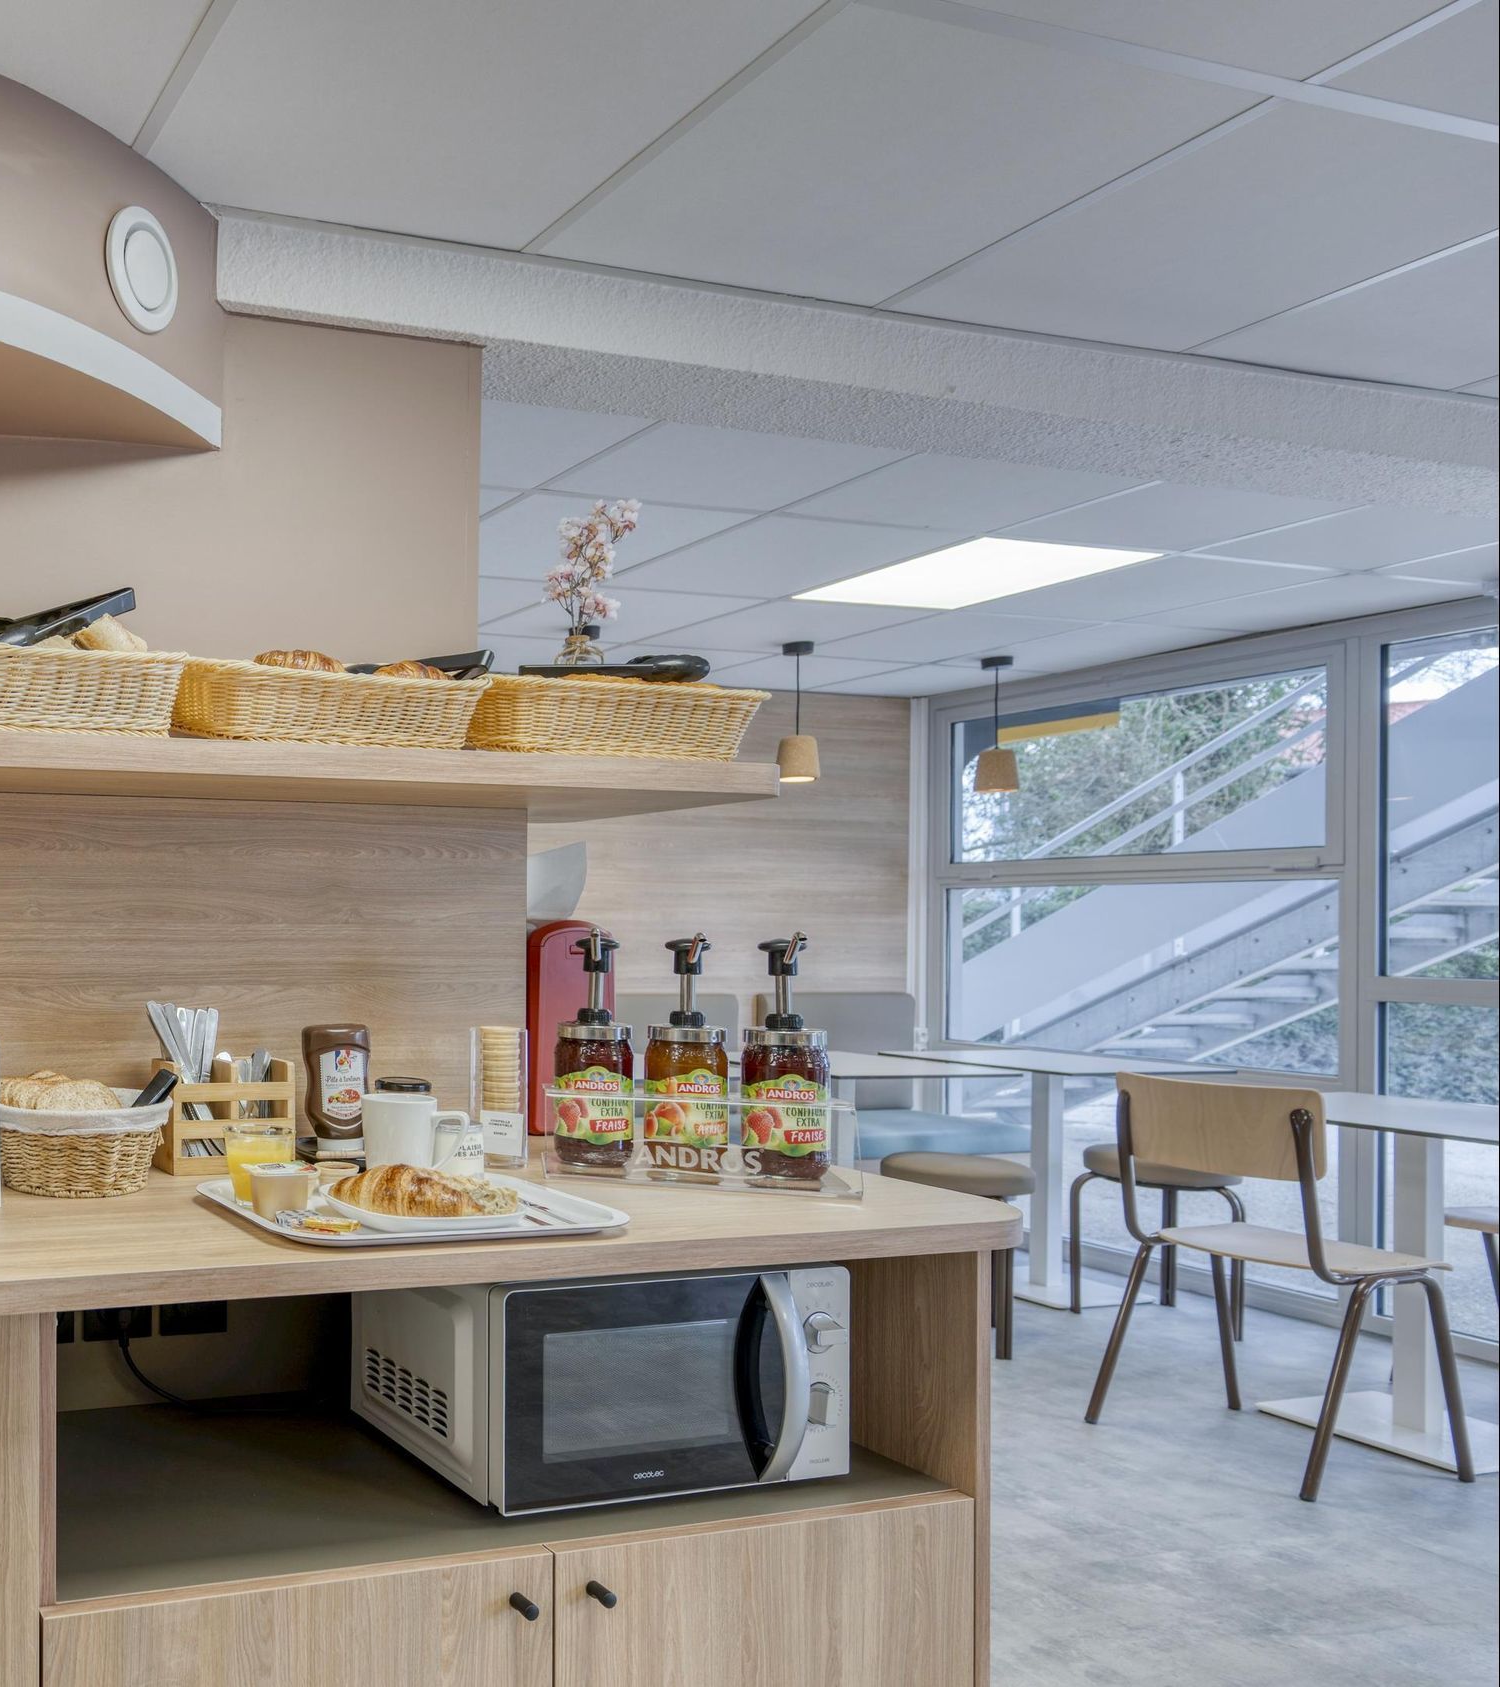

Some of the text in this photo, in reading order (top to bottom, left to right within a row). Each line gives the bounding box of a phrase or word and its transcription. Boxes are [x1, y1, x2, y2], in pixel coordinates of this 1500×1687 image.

[575, 1081, 618, 1091] ANDROS
[678, 1084, 720, 1093] ANDROS
[767, 1089, 814, 1100] ANDROS
[601, 1108, 623, 1116] EXTRA
[596, 1120, 626, 1131] FRAISE
[796, 1118, 820, 1127] EXTRA
[791, 1131, 824, 1142] FRAISE
[634, 1145, 762, 1175] ANDROS
[633, 1470, 665, 1480] cecotec
